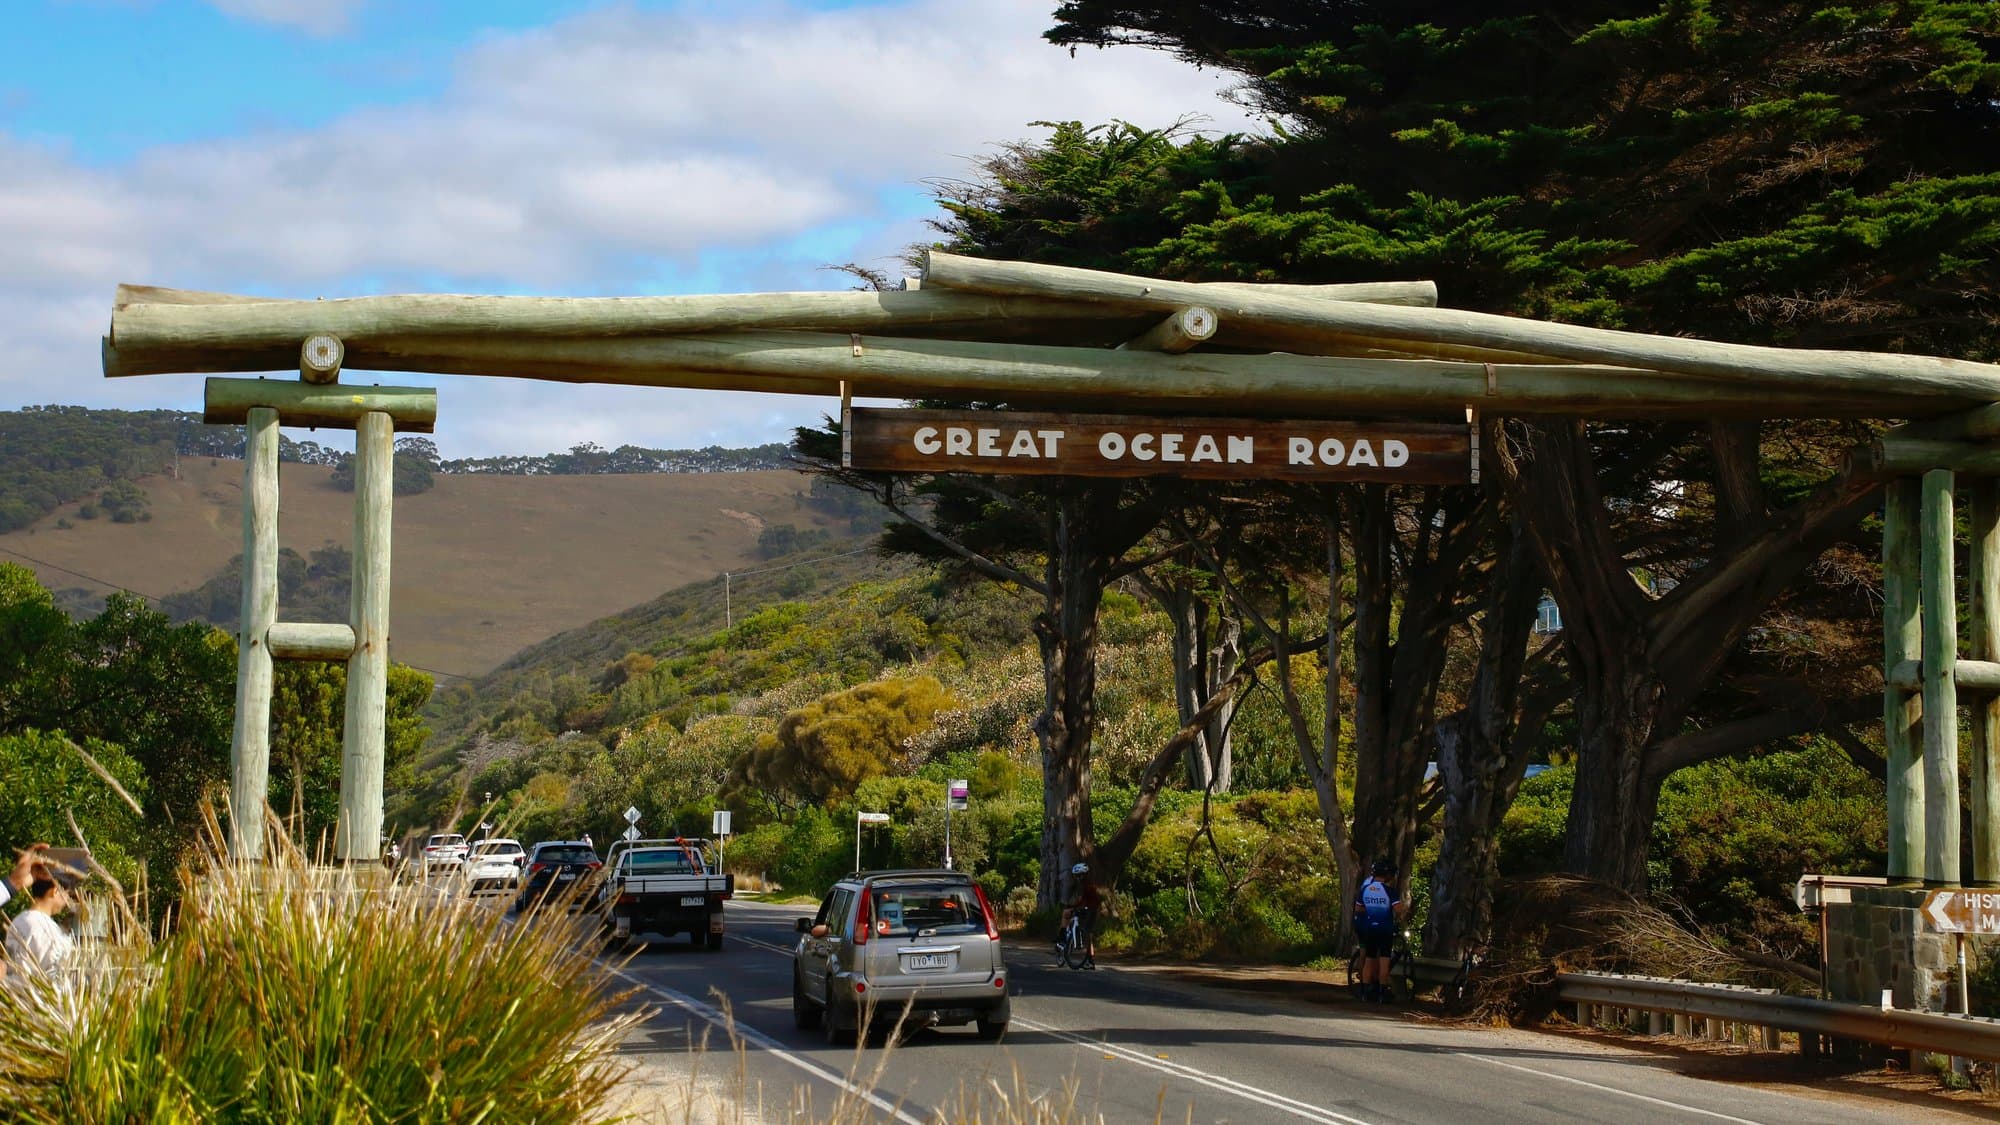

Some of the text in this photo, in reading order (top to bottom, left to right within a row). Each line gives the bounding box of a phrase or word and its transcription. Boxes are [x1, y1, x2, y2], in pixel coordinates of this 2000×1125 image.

[913, 427, 1409, 467] GREAT OCEAN ROAD
